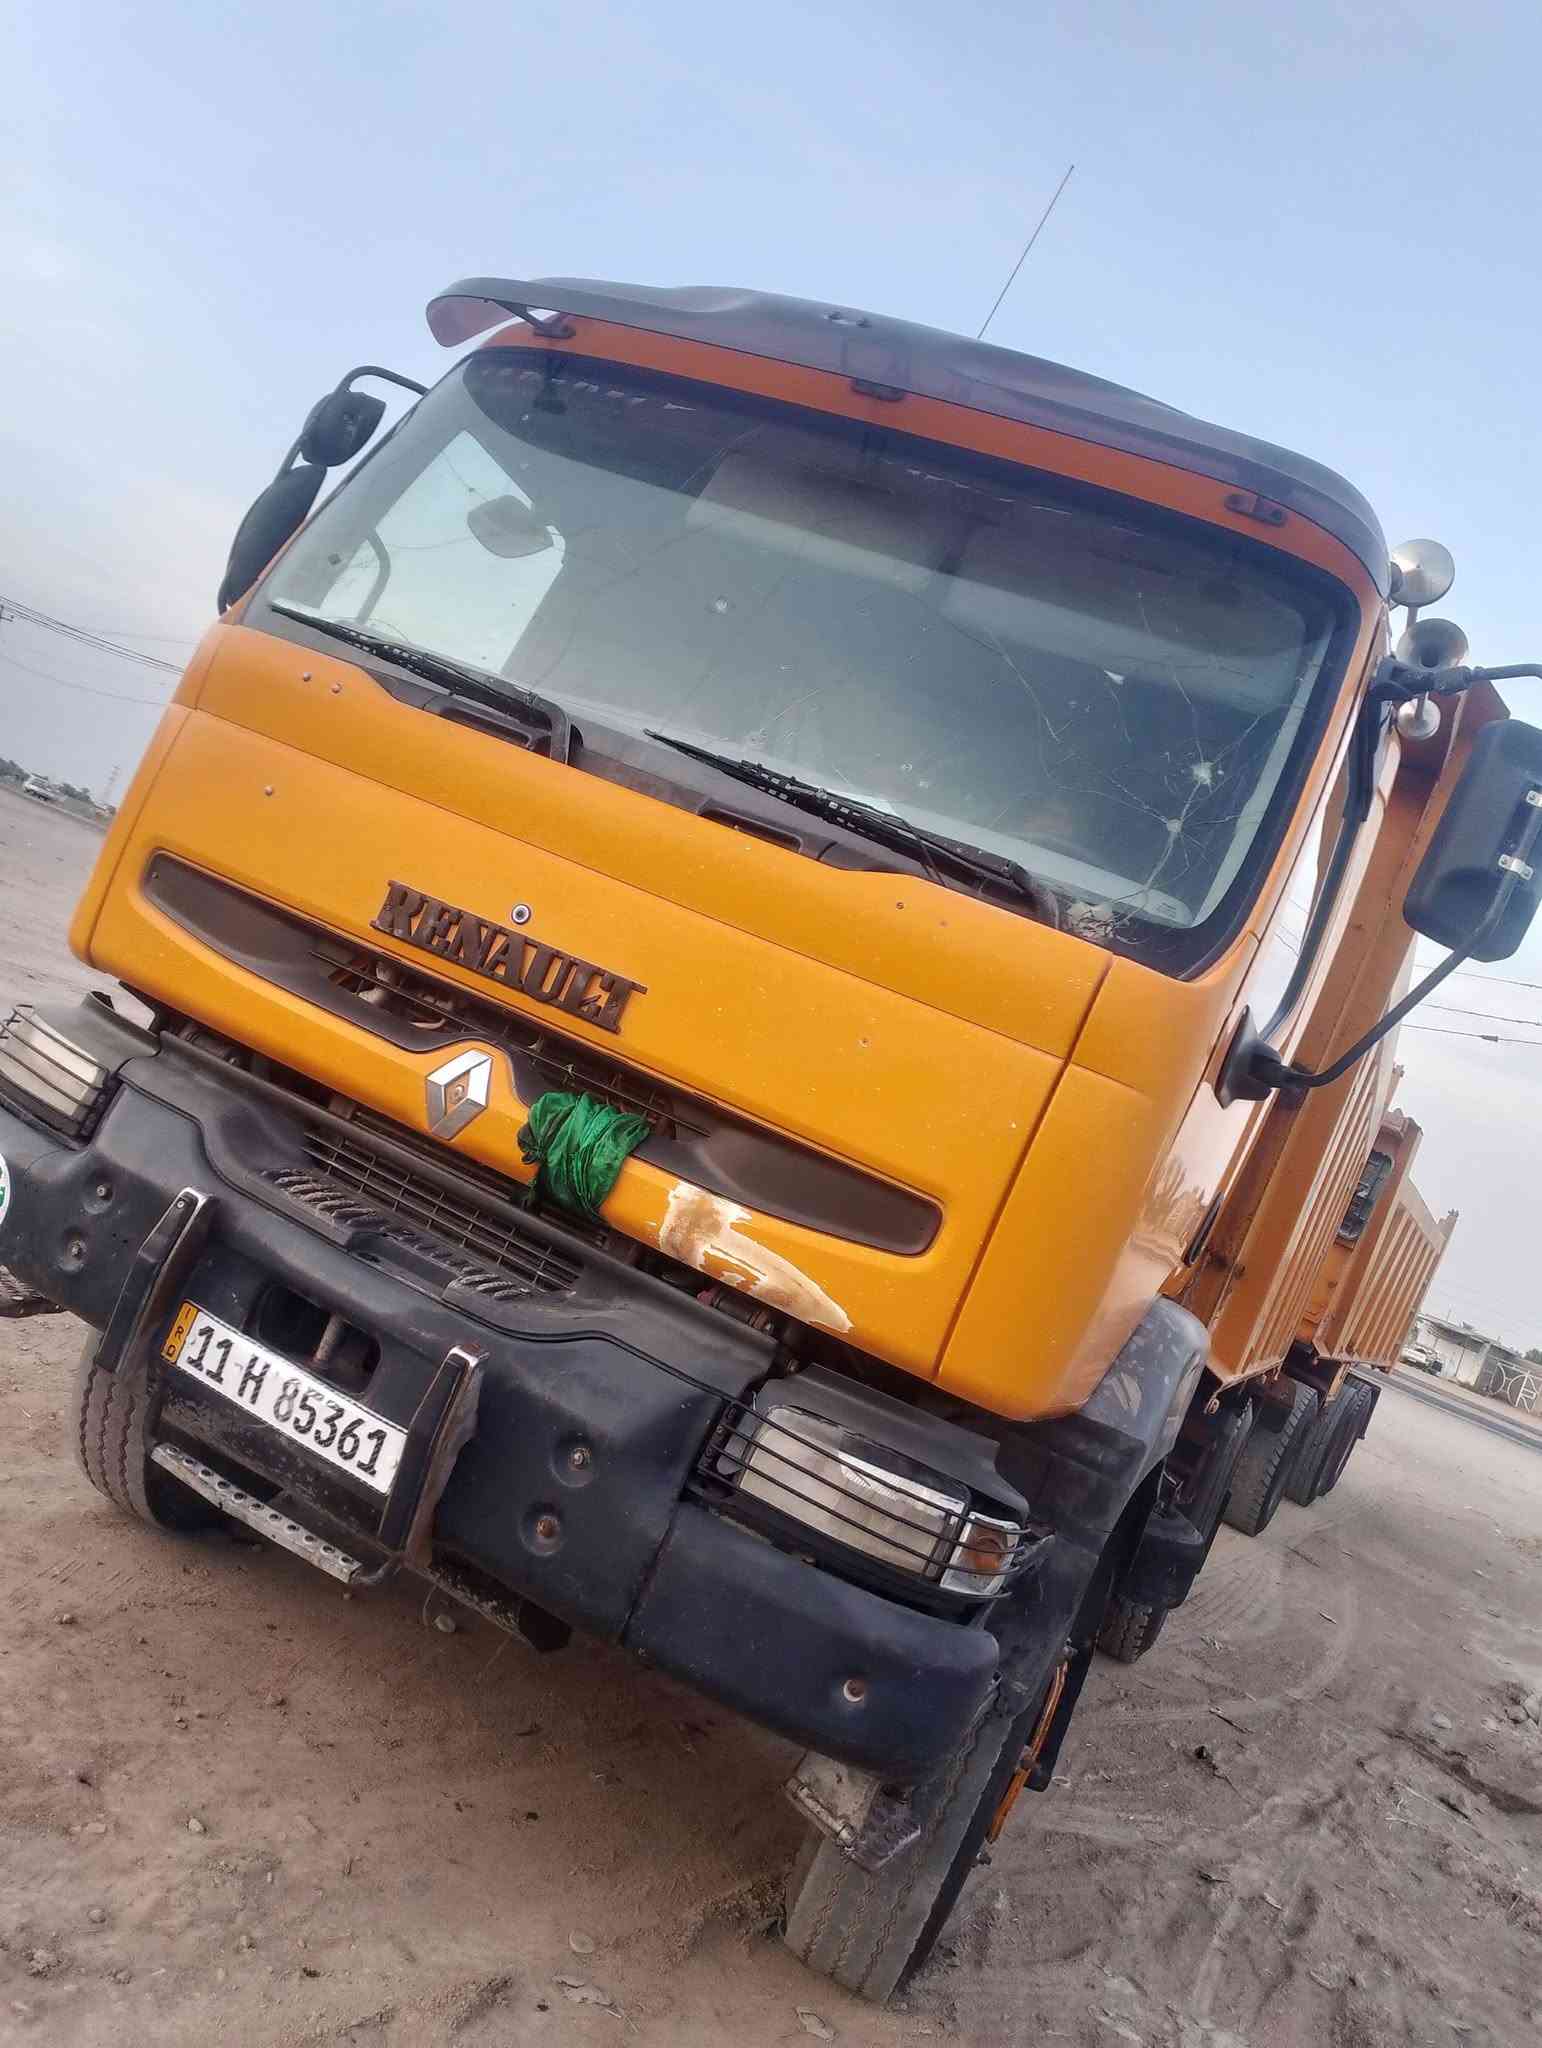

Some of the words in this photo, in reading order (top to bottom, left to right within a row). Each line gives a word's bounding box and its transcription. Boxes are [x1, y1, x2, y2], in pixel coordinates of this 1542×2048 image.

[369, 880, 648, 1035] RENAULT
[187, 1325, 234, 1386] 11
[237, 1354, 272, 1405] H
[272, 1378, 388, 1477] 85361
